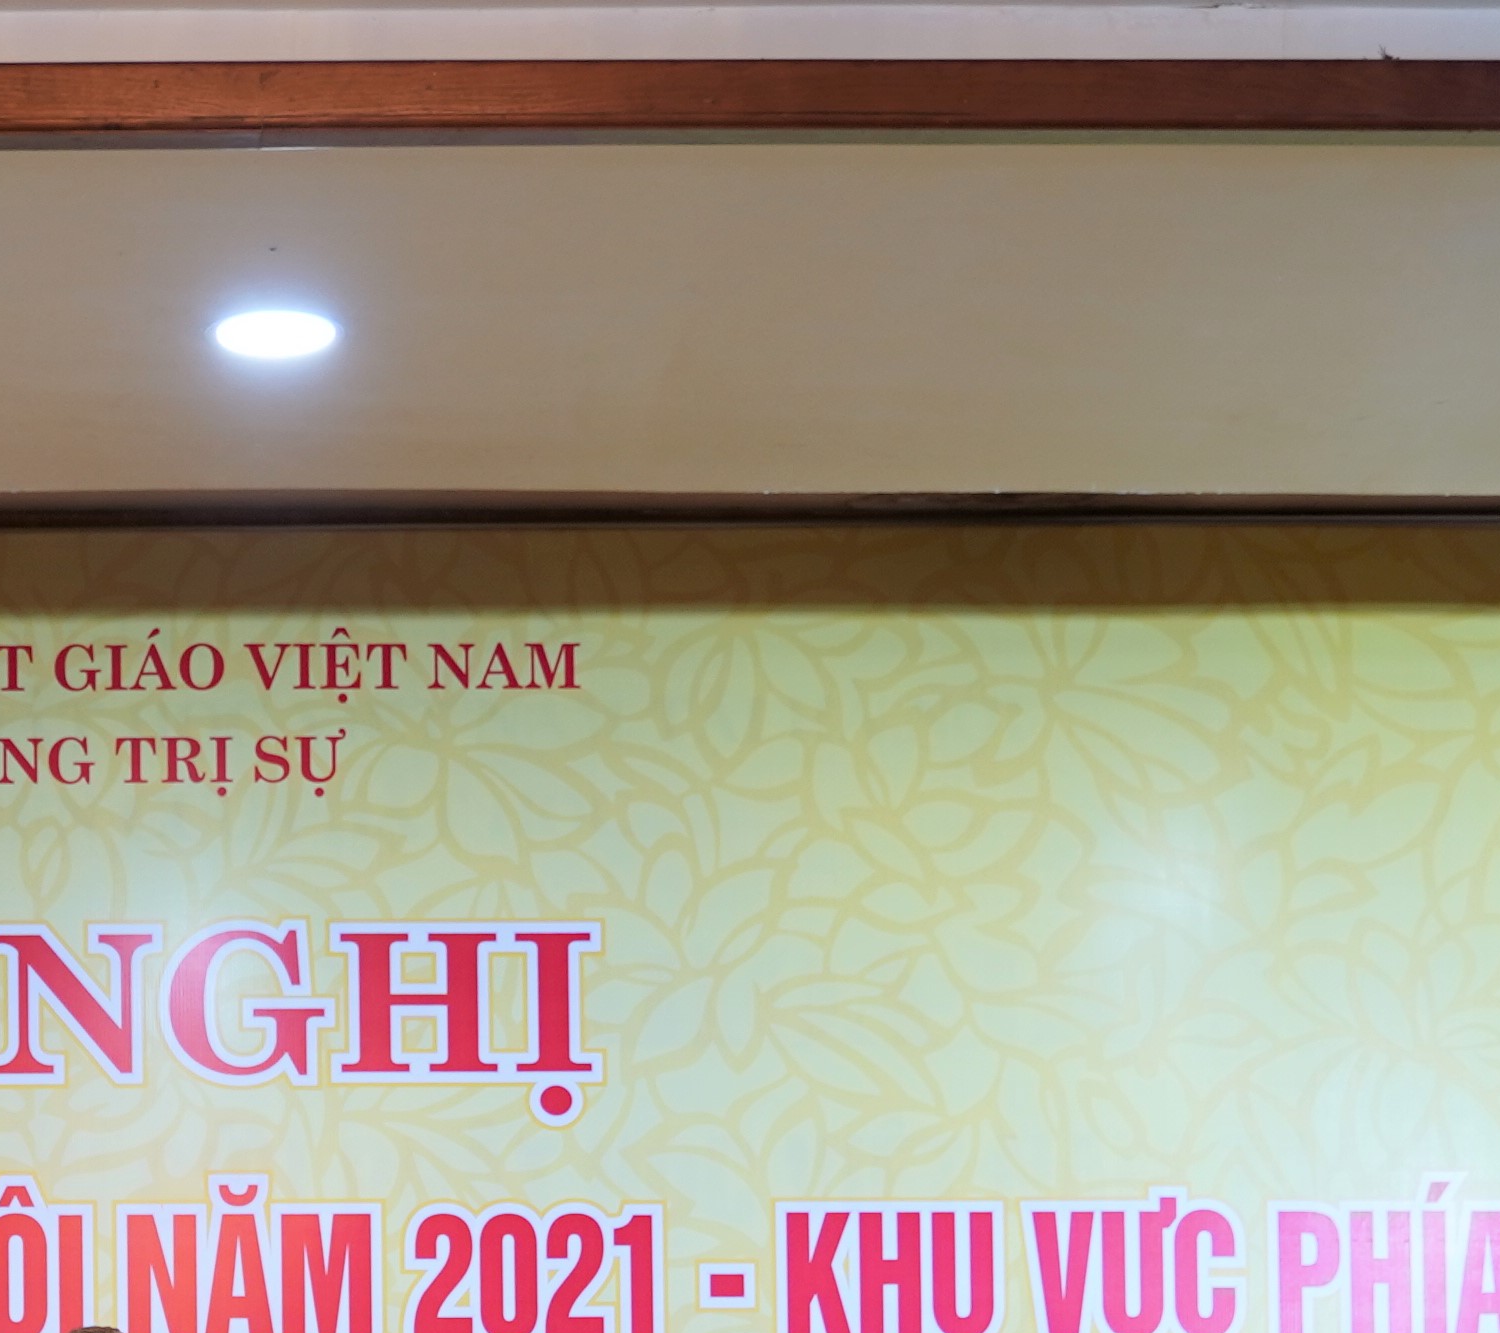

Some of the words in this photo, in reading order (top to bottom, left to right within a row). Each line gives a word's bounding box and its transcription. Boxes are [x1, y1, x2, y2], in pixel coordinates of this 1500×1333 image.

[55, 629, 226, 692] GIÁO
[247, 628, 408, 704] VIỆT
[431, 644, 581, 690] NAM
[116, 738, 230, 798] TRỊ
[255, 730, 346, 798] SỰ
[710, 1274, 746, 1299] -
